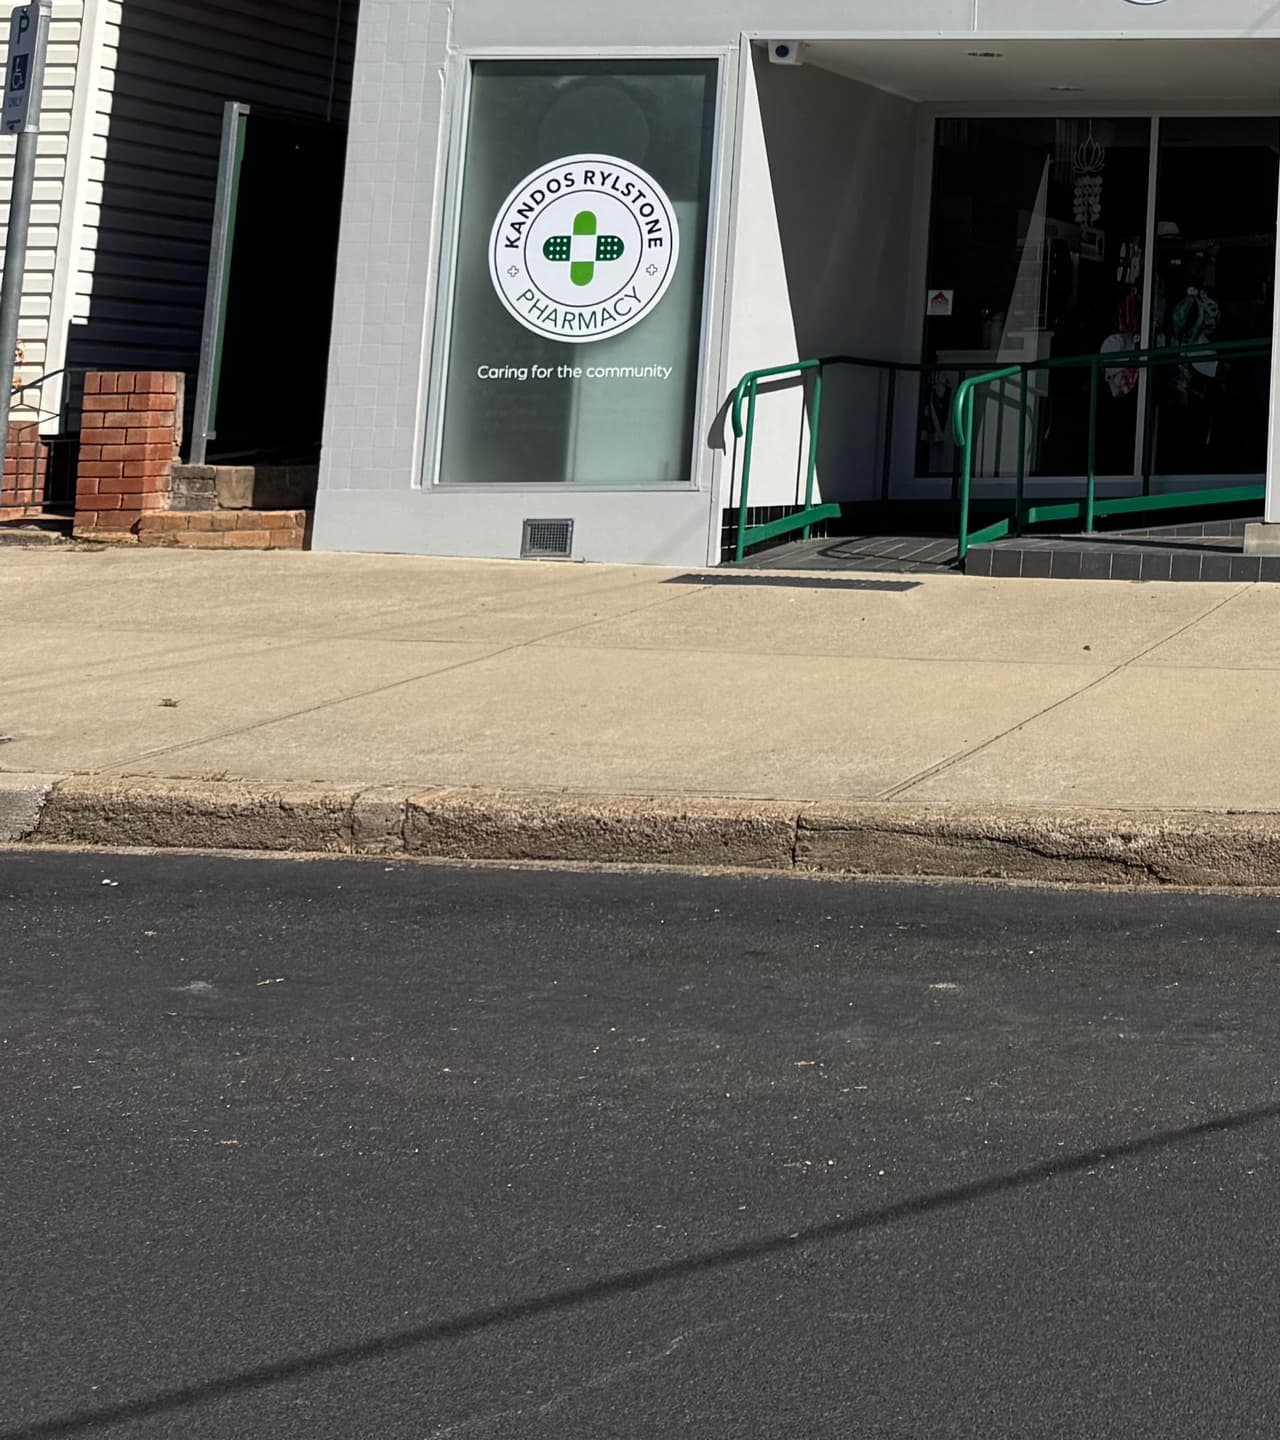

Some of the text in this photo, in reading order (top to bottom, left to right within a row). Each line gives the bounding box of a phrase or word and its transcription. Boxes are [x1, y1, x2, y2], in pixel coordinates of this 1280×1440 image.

[16, 14, 29, 44] P
[504, 168, 664, 252] KANDOS RYLSTONE
[516, 286, 642, 330] PHARMACY
[477, 363, 672, 380] Caring for the community
